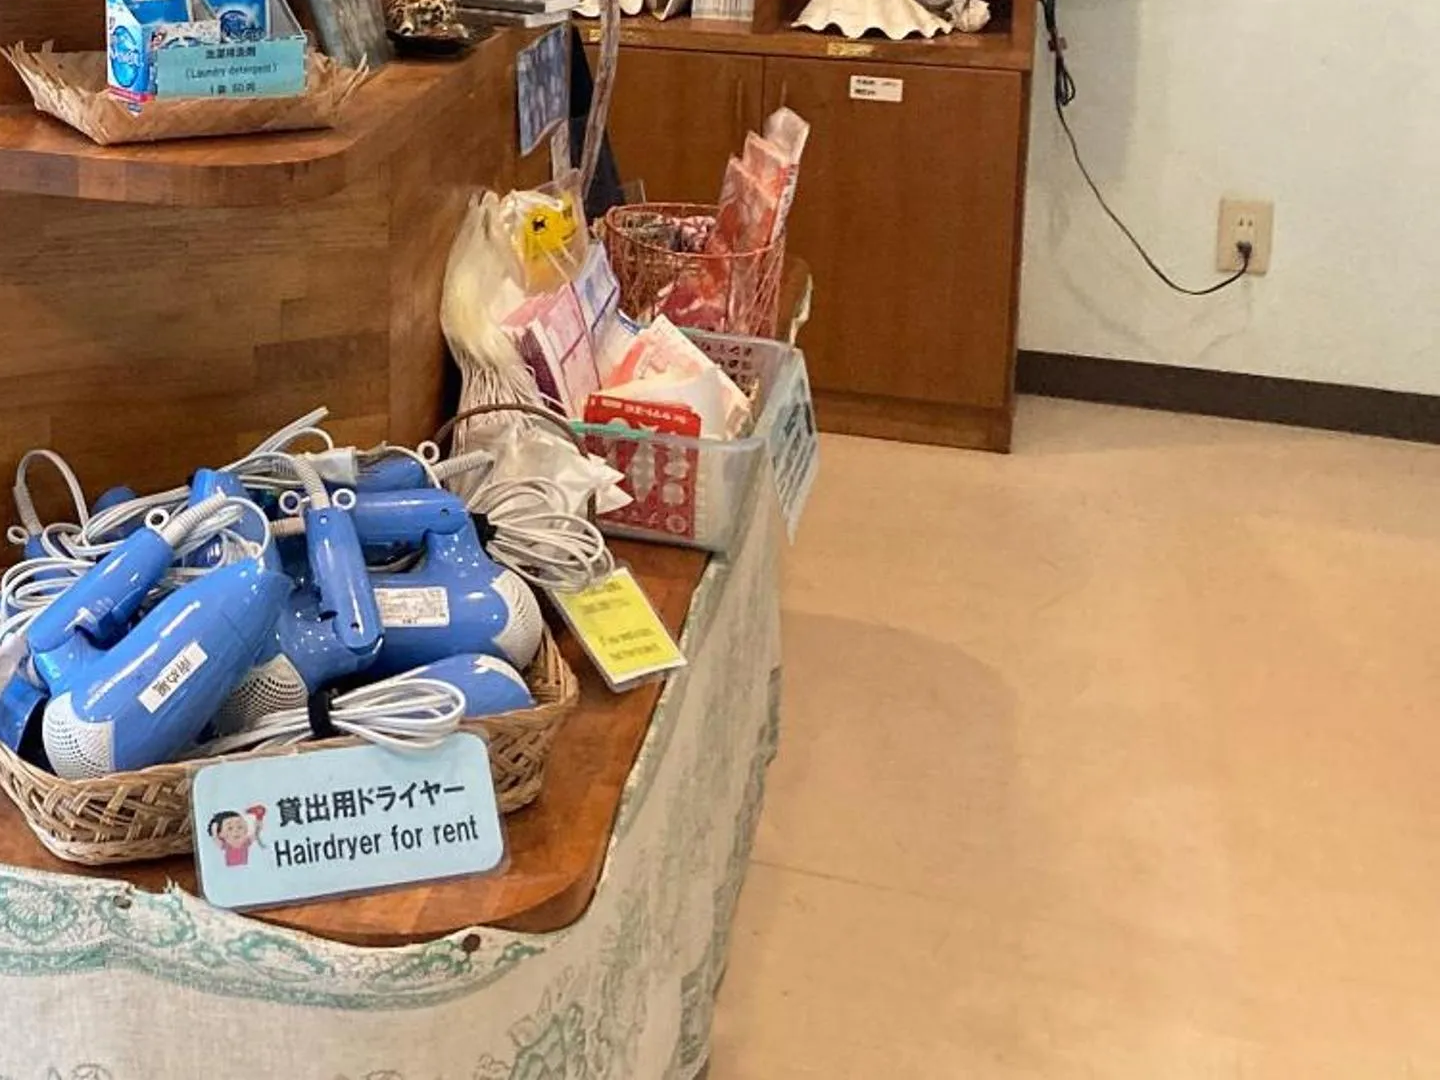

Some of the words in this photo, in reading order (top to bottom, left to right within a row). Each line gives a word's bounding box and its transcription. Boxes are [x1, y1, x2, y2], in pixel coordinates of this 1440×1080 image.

[277, 779, 466, 827] 貸出用ドライヤー
[274, 833, 382, 867] Hairdryer
[391, 824, 424, 851] for
[433, 814, 480, 846] rent
